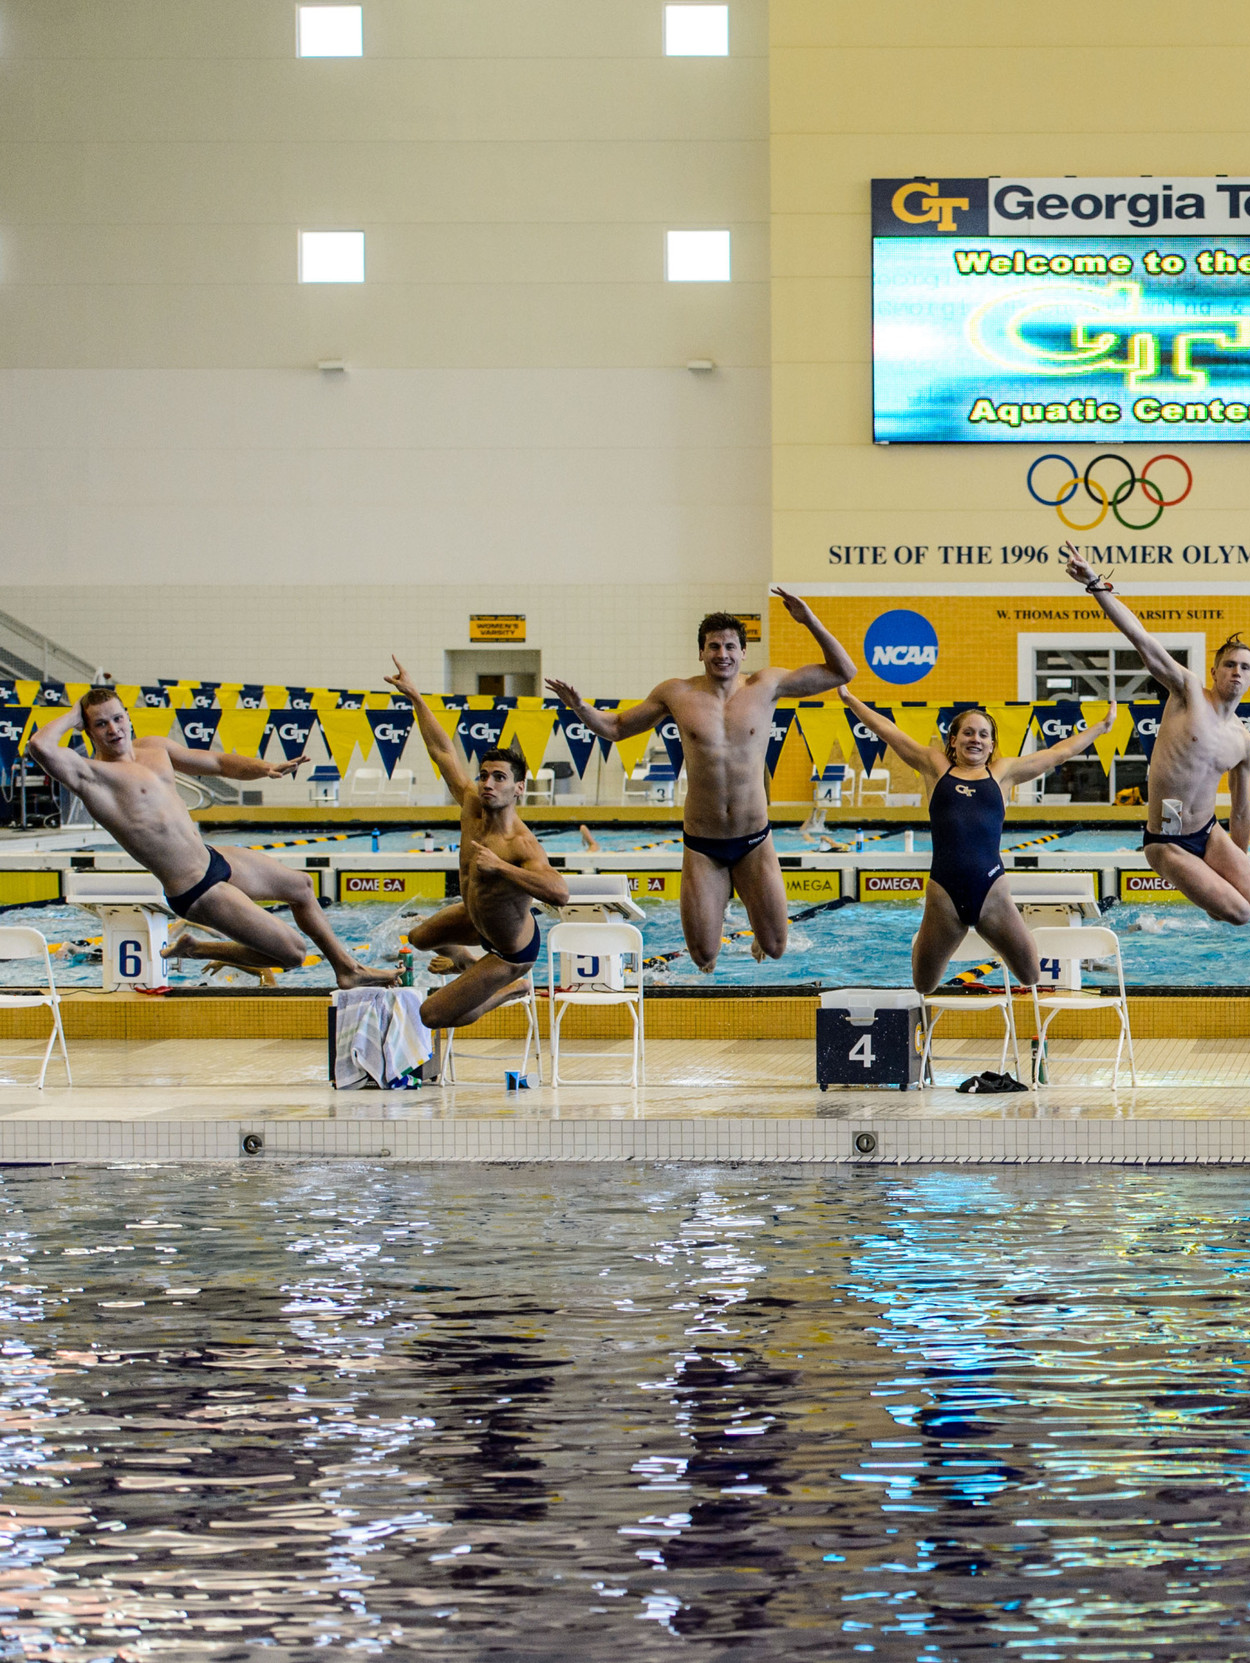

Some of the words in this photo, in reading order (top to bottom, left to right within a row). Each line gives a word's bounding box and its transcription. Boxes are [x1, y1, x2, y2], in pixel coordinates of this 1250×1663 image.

[891, 182, 969, 231] GT
[994, 184, 1206, 228] Georgia
[954, 249, 1133, 275] Welcome
[1143, 249, 1186, 275] to
[968, 397, 1122, 427] Aquatic
[829, 545, 887, 565] SITE
[894, 545, 929, 565] OF
[938, 545, 993, 565] THE
[1000, 545, 1049, 564] 1996
[996, 610, 1011, 620] W.
[1014, 610, 1069, 620] THOMAS
[1186, 609, 1224, 620] SUITE
[872, 645, 937, 665] NCAA
[184, 722, 215, 742] GT
[279, 723, 309, 743] GT
[374, 723, 404, 743] GT
[470, 723, 500, 743] GT
[566, 723, 596, 743] GT
[1042, 719, 1072, 739] GT
[656, 788, 665, 802] 3
[787, 880, 833, 891] MEGA
[868, 878, 921, 890] OMEGA
[1130, 878, 1176, 890] OMEG
[119, 940, 142, 978] 6
[849, 1034, 876, 1068] 4
